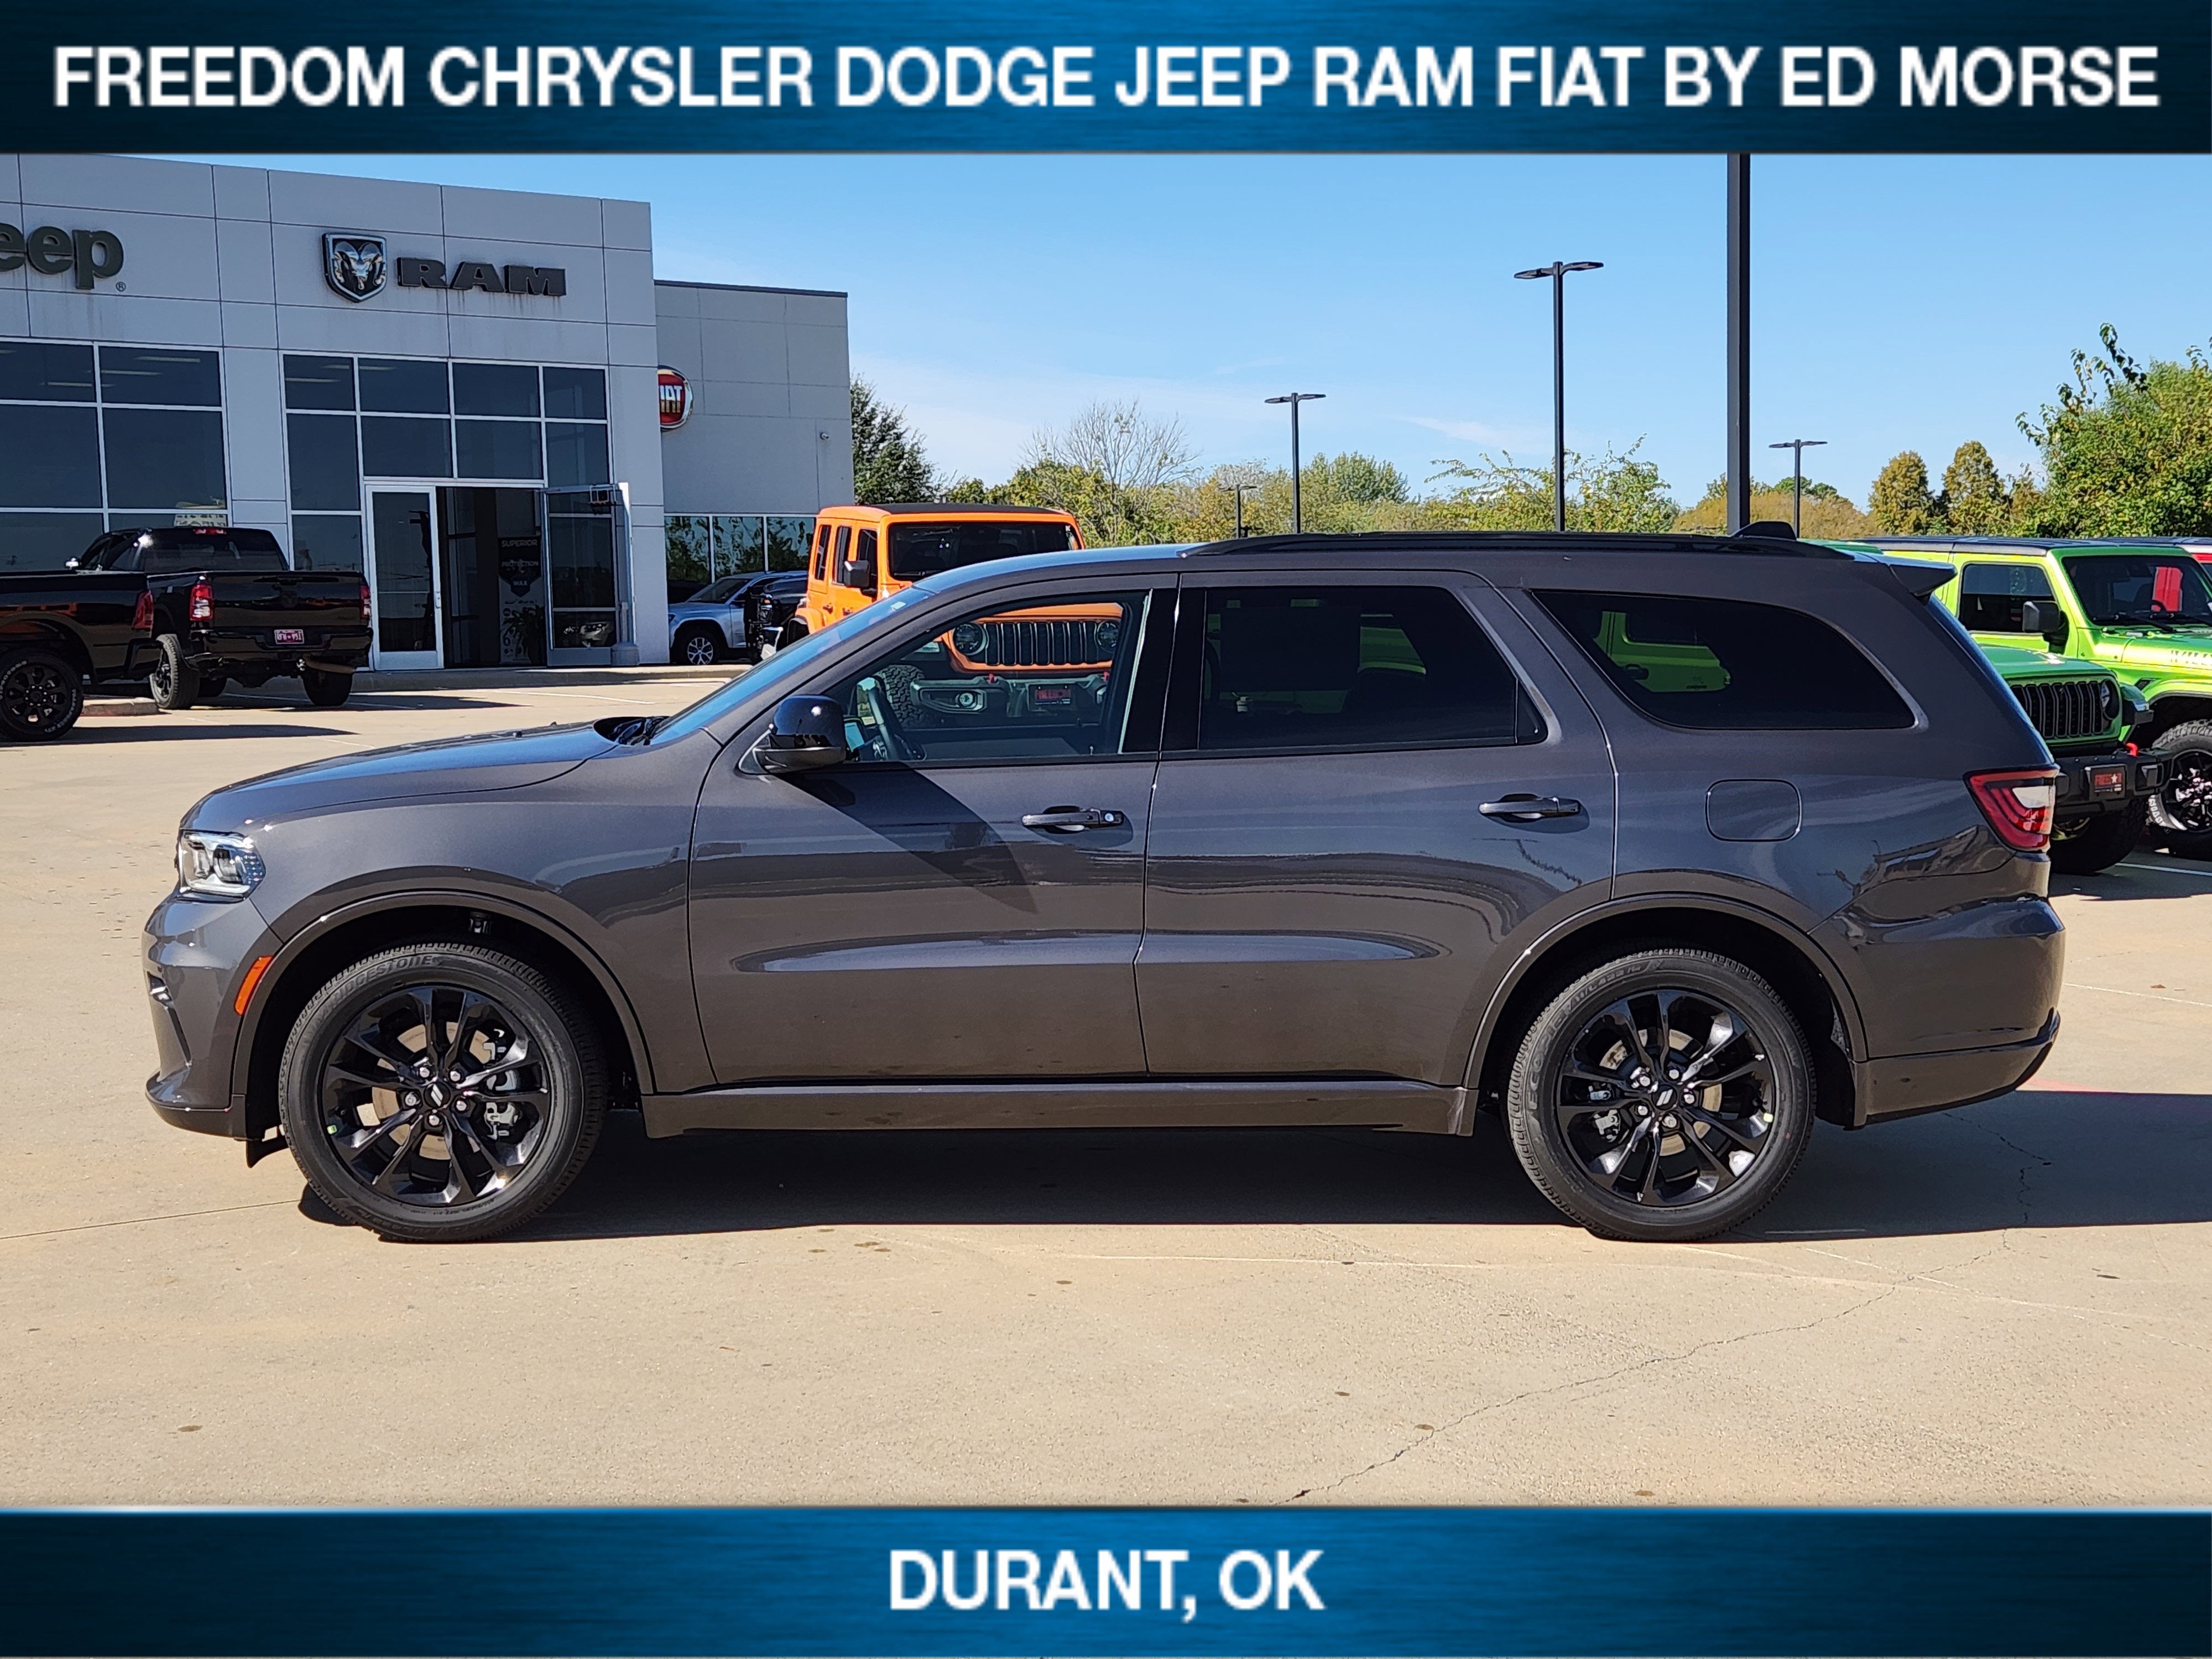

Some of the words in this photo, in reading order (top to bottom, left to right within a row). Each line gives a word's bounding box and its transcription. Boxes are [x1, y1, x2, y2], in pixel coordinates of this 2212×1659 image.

[0, 223, 124, 290] eep
[397, 257, 567, 296] RAM
[660, 384, 683, 413] IAT
[501, 539, 538, 547] SUPERIOR
